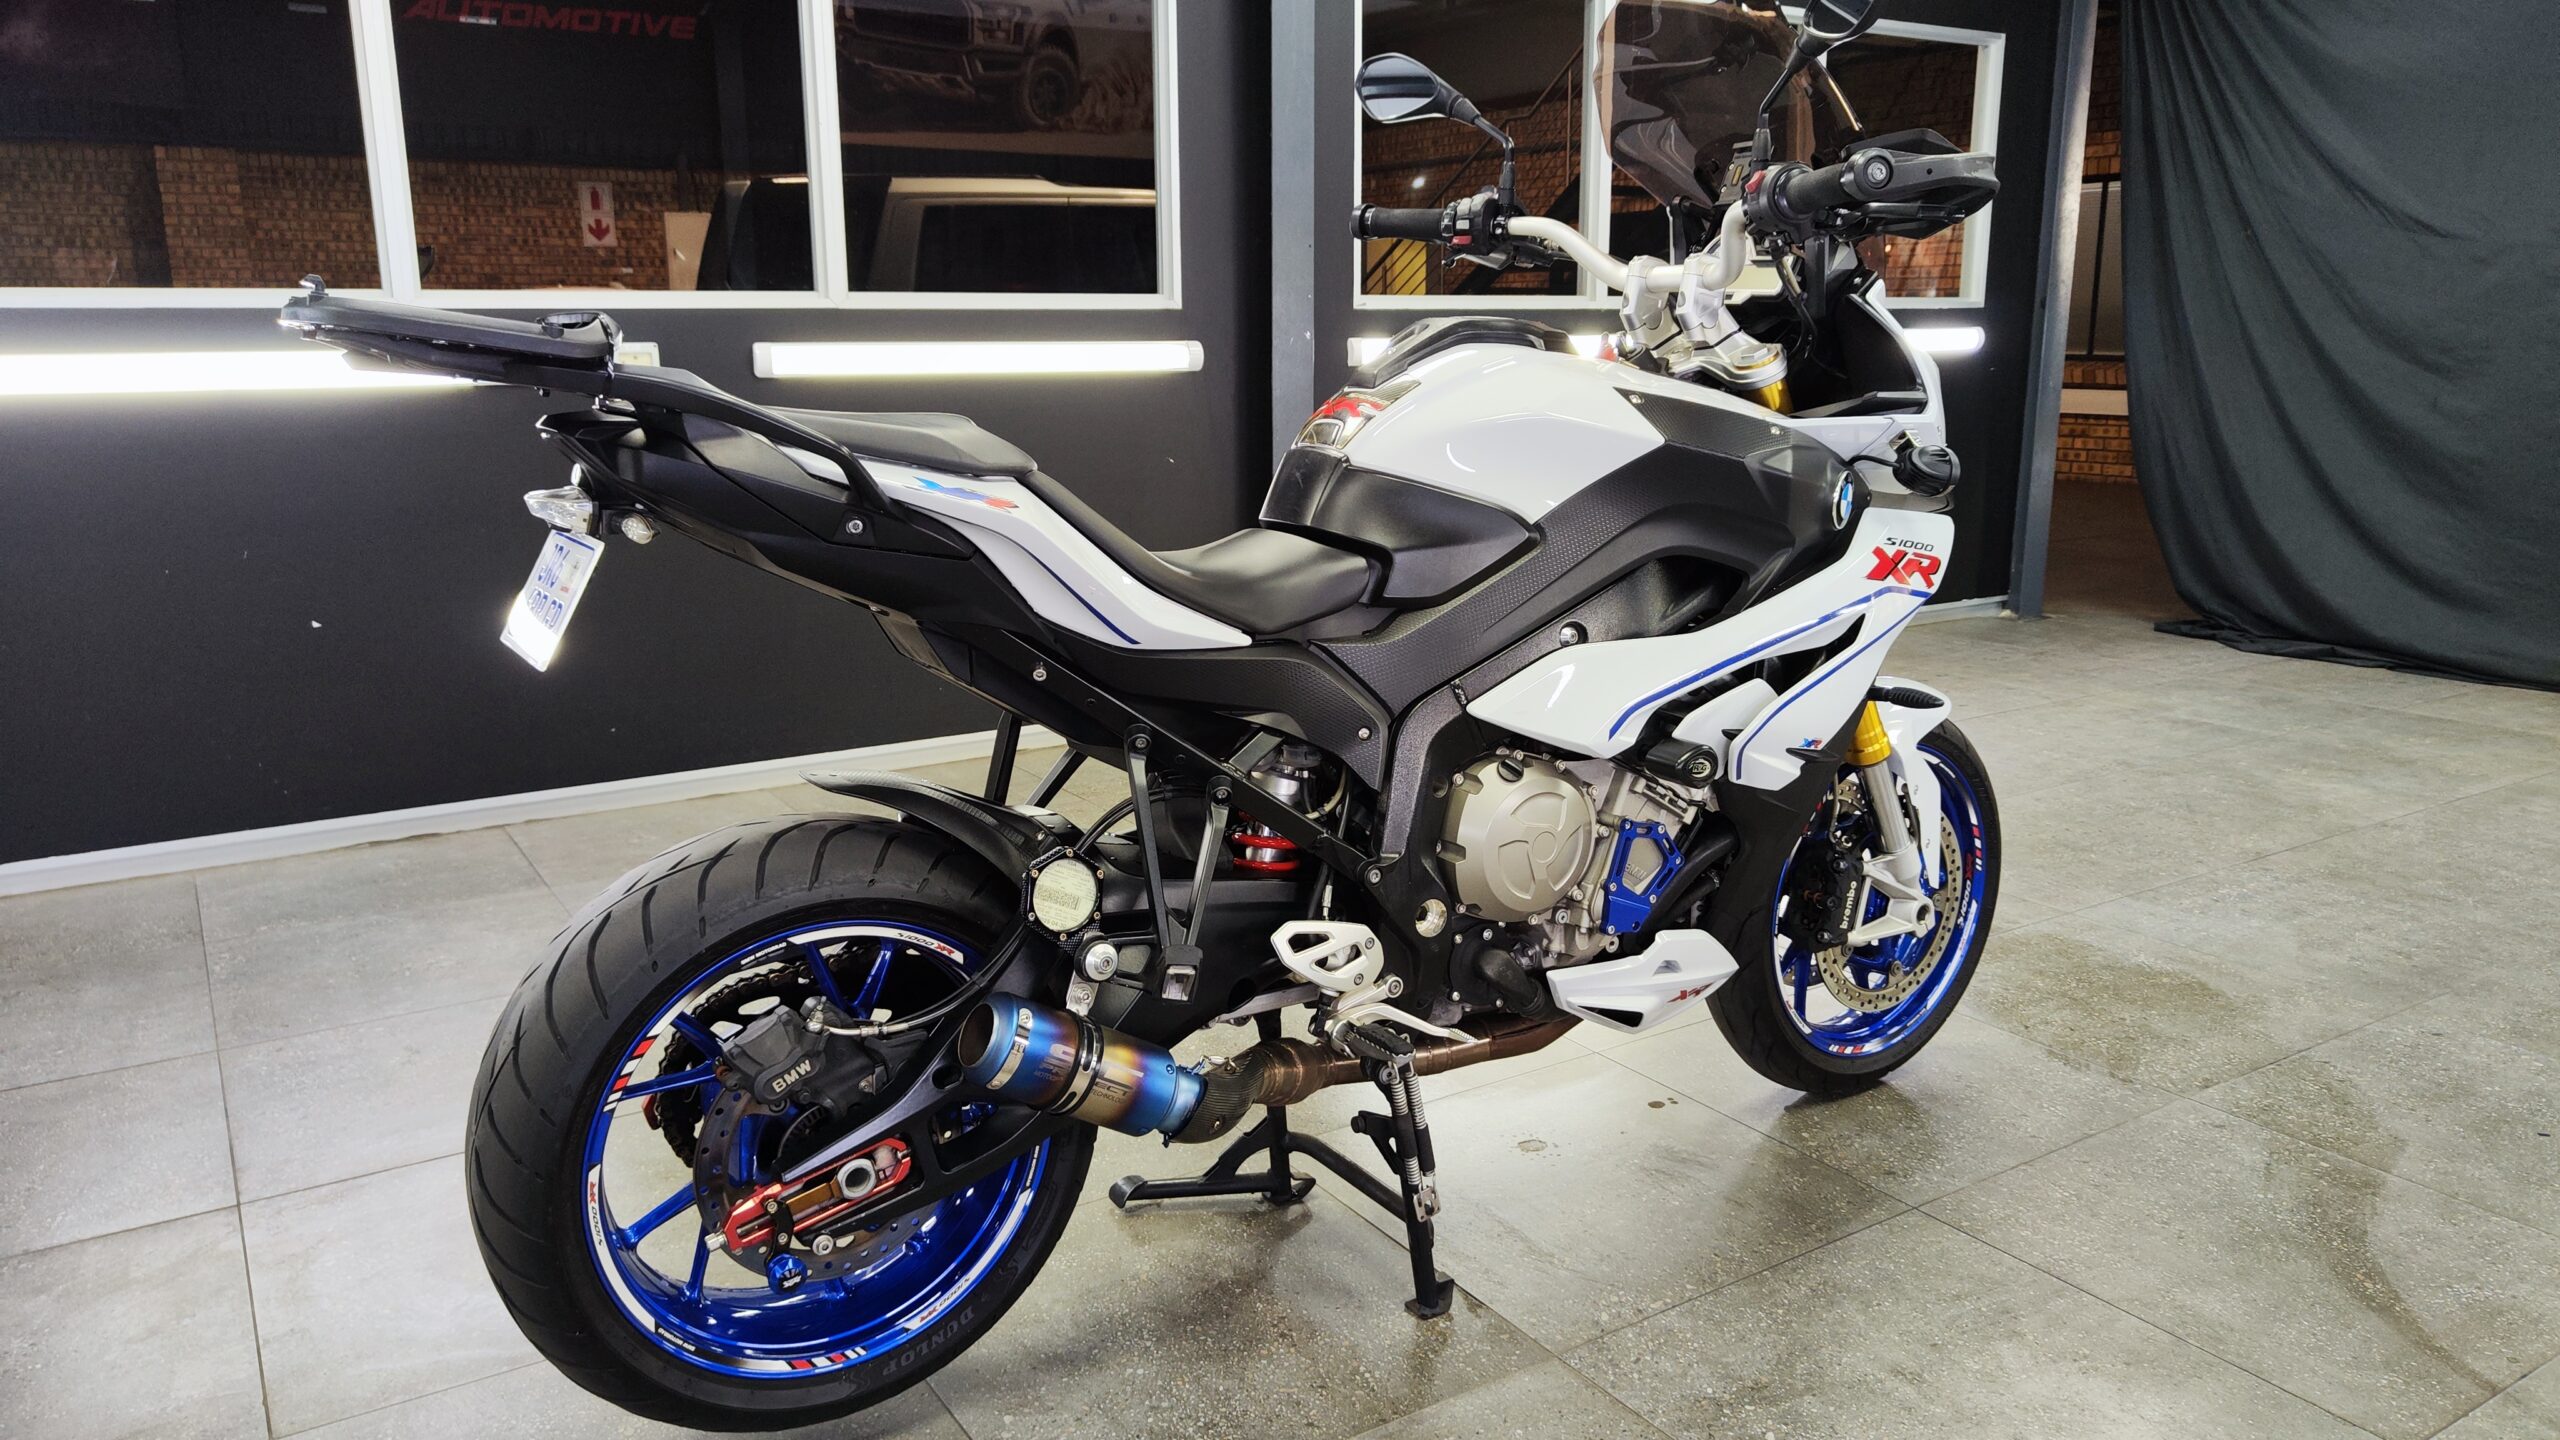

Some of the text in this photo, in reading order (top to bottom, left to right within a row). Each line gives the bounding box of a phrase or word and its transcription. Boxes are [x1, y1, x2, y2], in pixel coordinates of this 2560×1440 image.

[402, 0, 697, 40] AUTOMOTIVE
[1883, 537, 1934, 552] S1000
[1864, 546, 1941, 589] XR
[1840, 881, 1857, 929] brembo
[772, 1059, 812, 1093] BMW
[882, 1304, 975, 1377] DUNLOP
